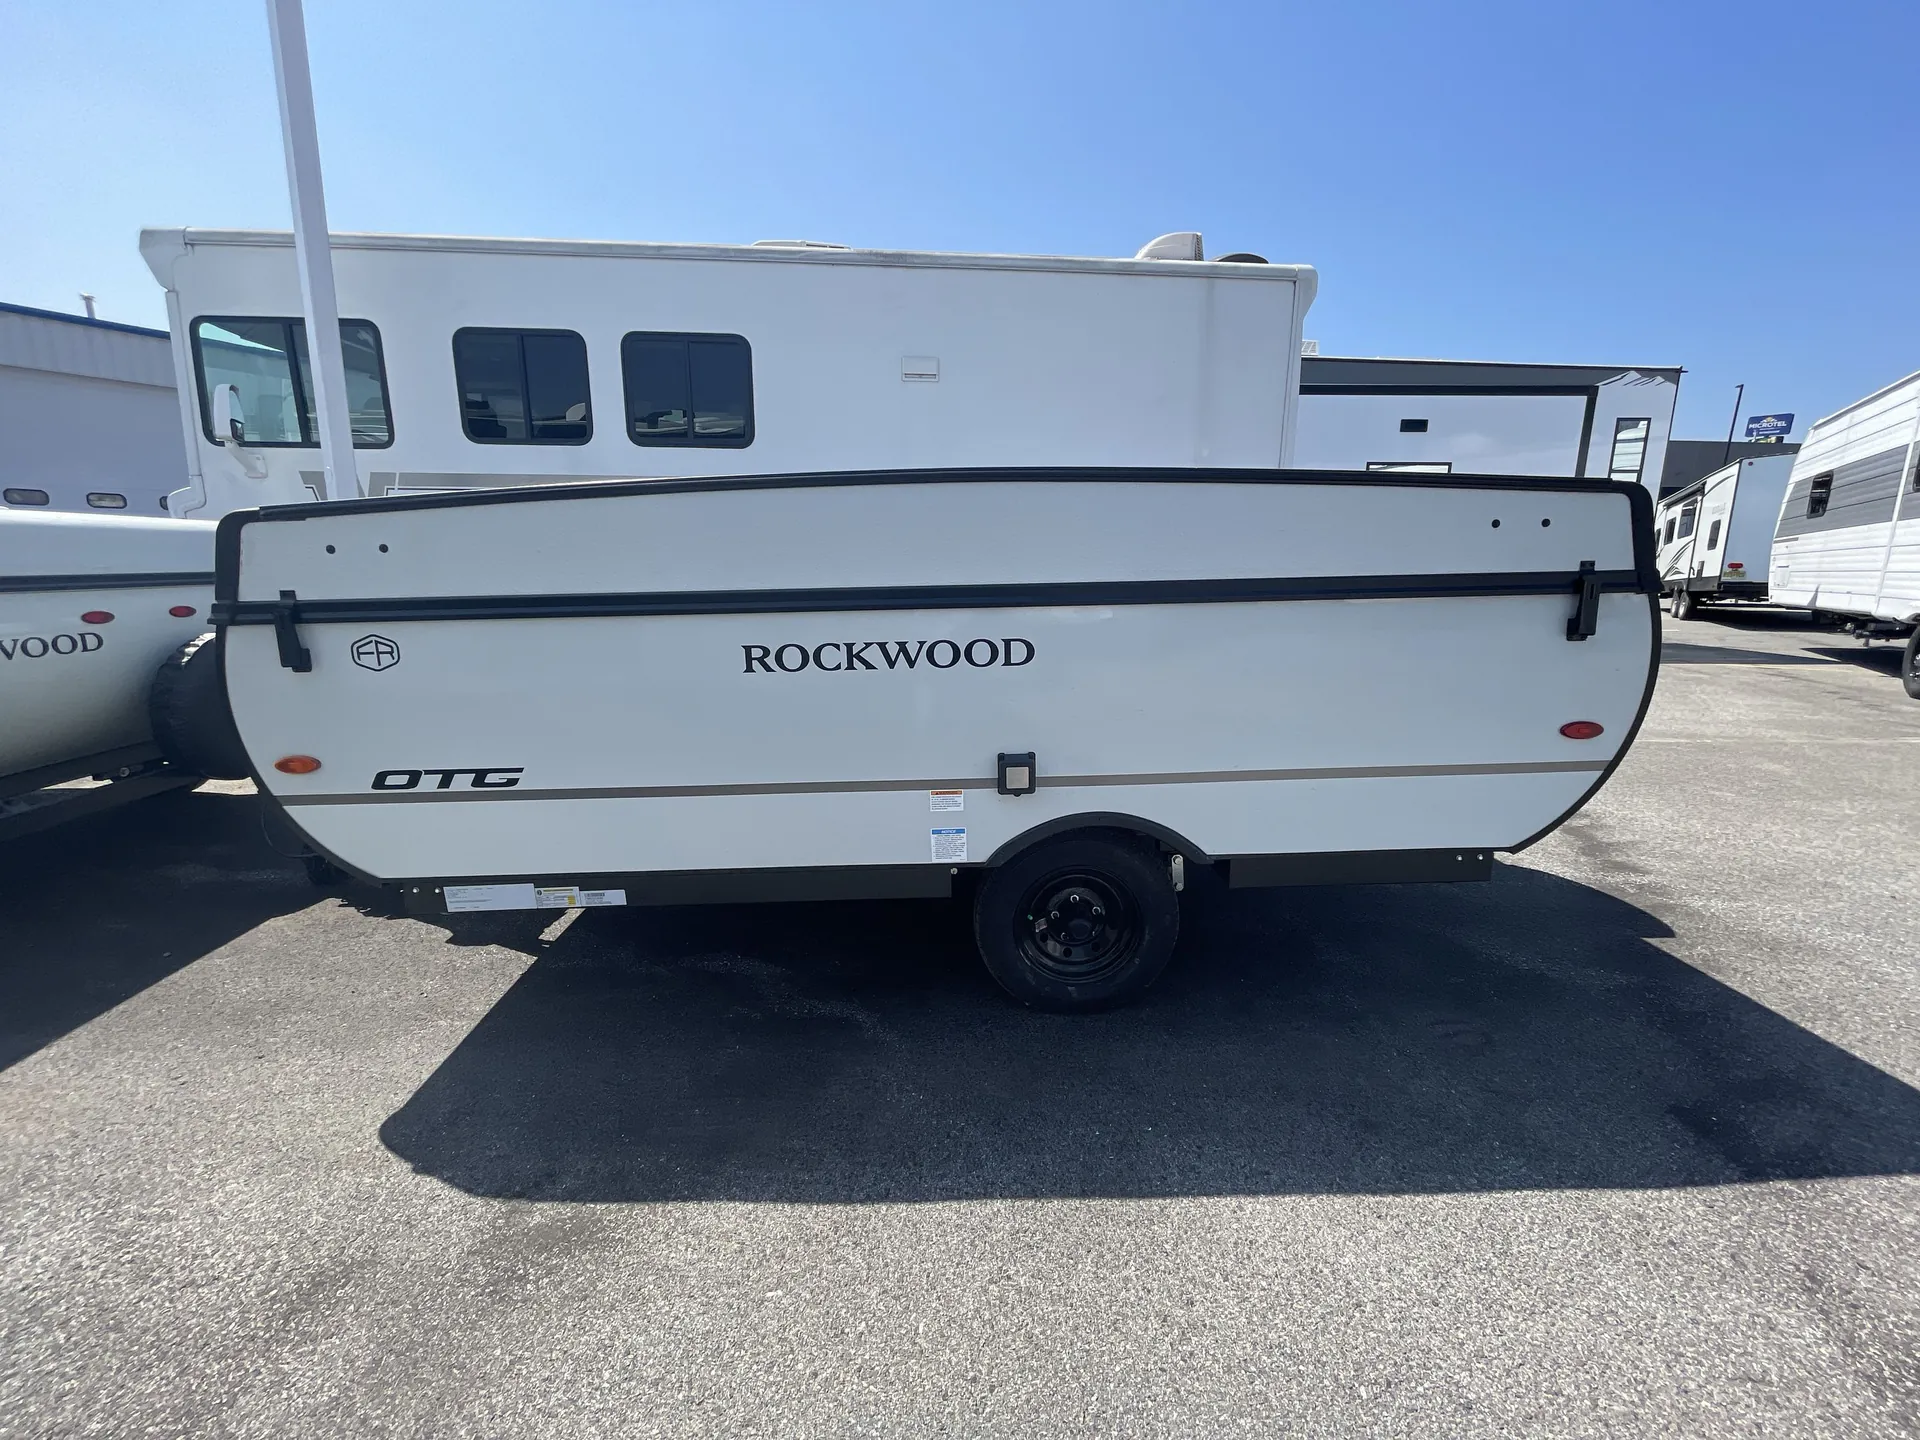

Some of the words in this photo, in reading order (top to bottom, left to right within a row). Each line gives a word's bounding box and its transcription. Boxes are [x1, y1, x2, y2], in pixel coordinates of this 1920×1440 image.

[1748, 420, 1787, 429] MICROTEL
[741, 638, 1036, 673] ROCKWOOD
[371, 767, 525, 790] OTG
